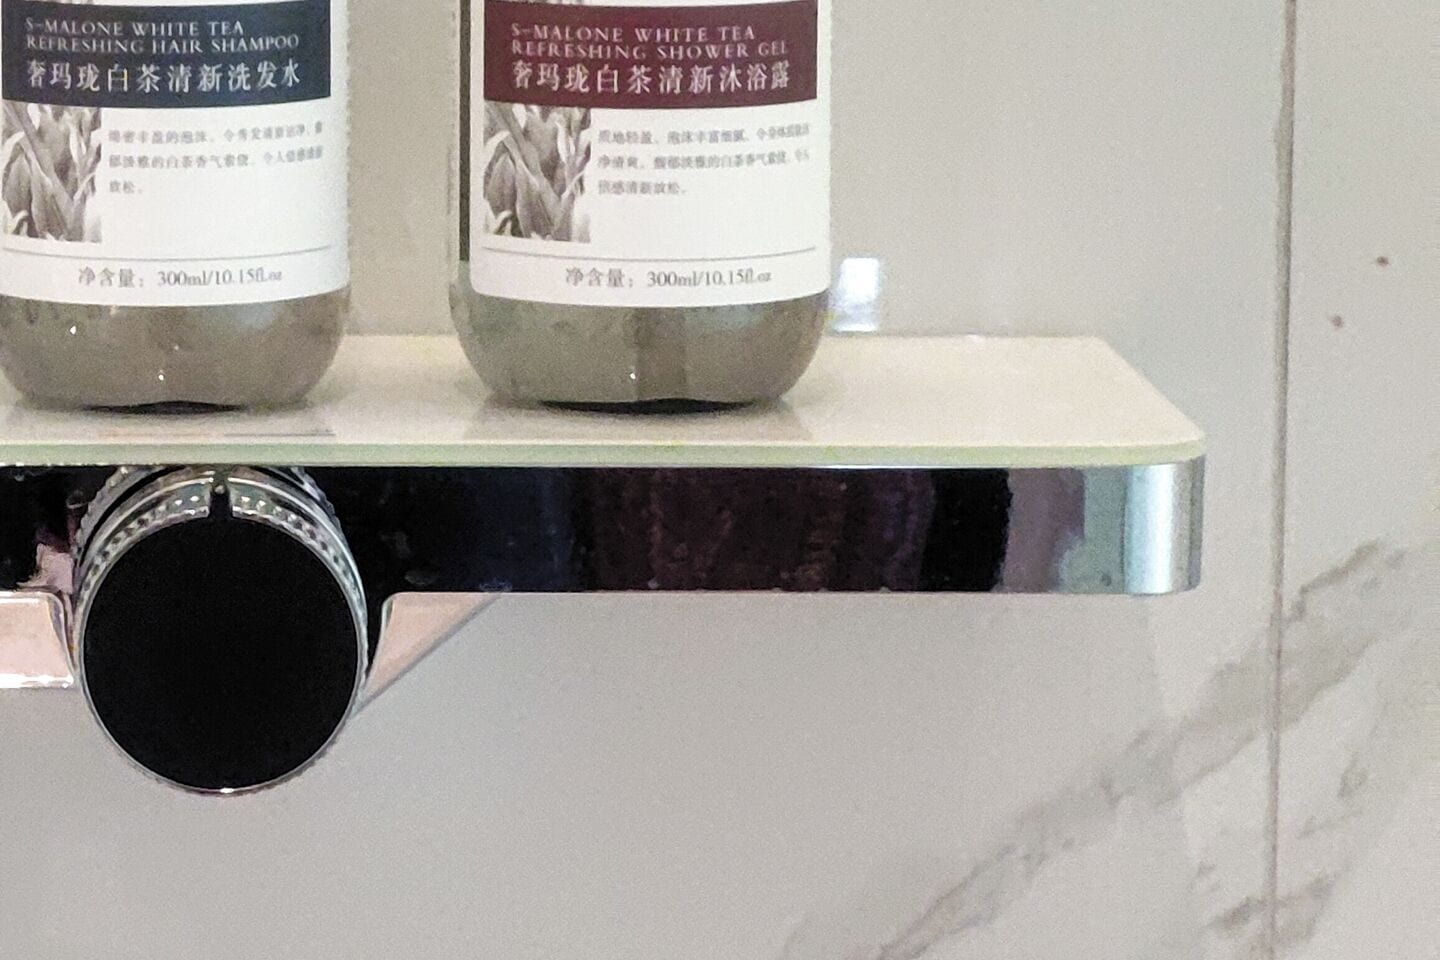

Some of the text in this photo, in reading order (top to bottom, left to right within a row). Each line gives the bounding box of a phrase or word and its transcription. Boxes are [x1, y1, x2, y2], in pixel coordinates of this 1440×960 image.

[26, 16, 244, 37] S-MALONE WHITE TEA
[511, 22, 755, 43] S-MALONE WHITE TEA
[26, 33, 300, 55] REFRESHING HAIR SHAMPOO
[511, 39, 788, 61] REFRESHING SHOWER GEL
[27, 58, 301, 94] 奢玛珑白茶清新洗发水
[512, 59, 790, 95] 奢玛珑白茶清新沐浴露
